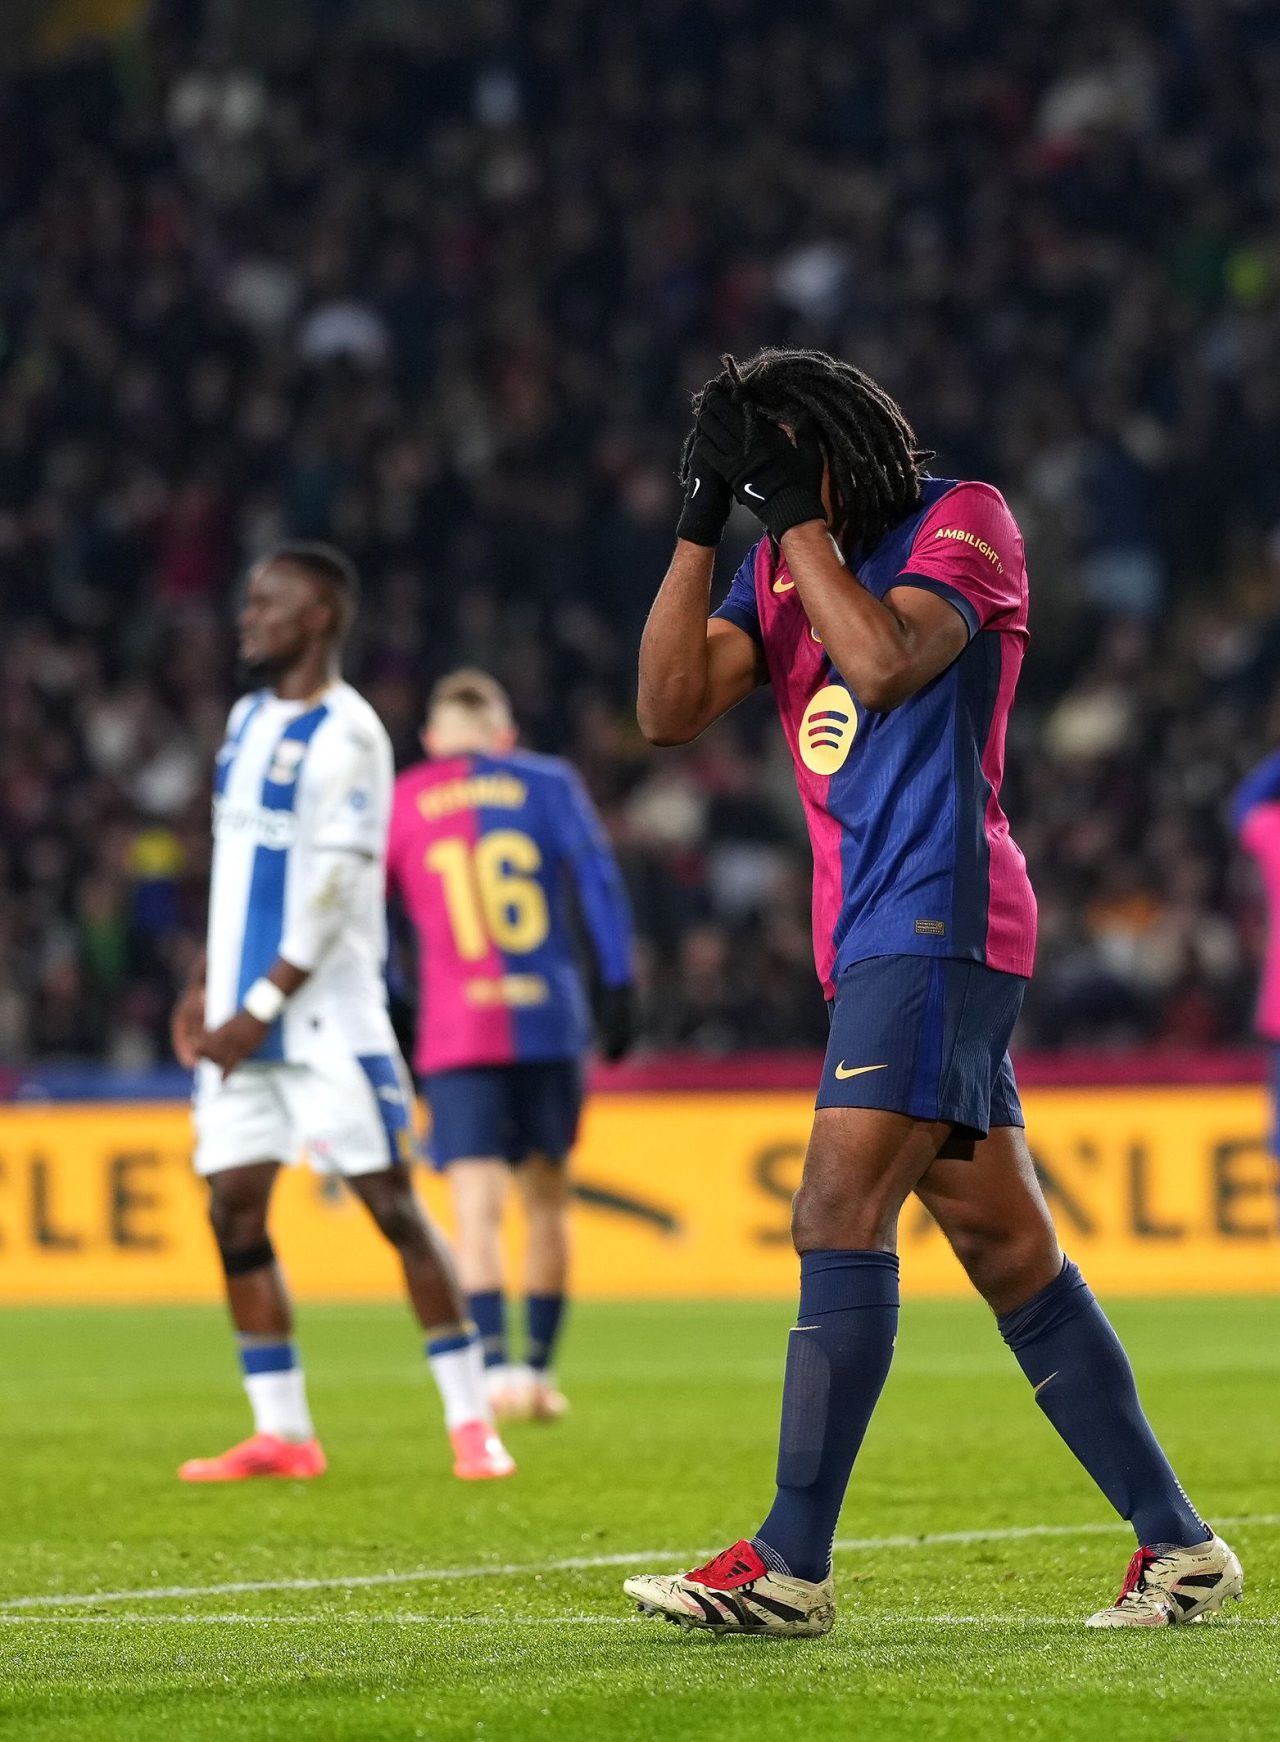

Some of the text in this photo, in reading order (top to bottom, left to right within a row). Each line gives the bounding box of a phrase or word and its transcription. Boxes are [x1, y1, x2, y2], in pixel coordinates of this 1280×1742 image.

[934, 528, 1004, 574] AMBILIGHT tv
[424, 828, 549, 962] 16
